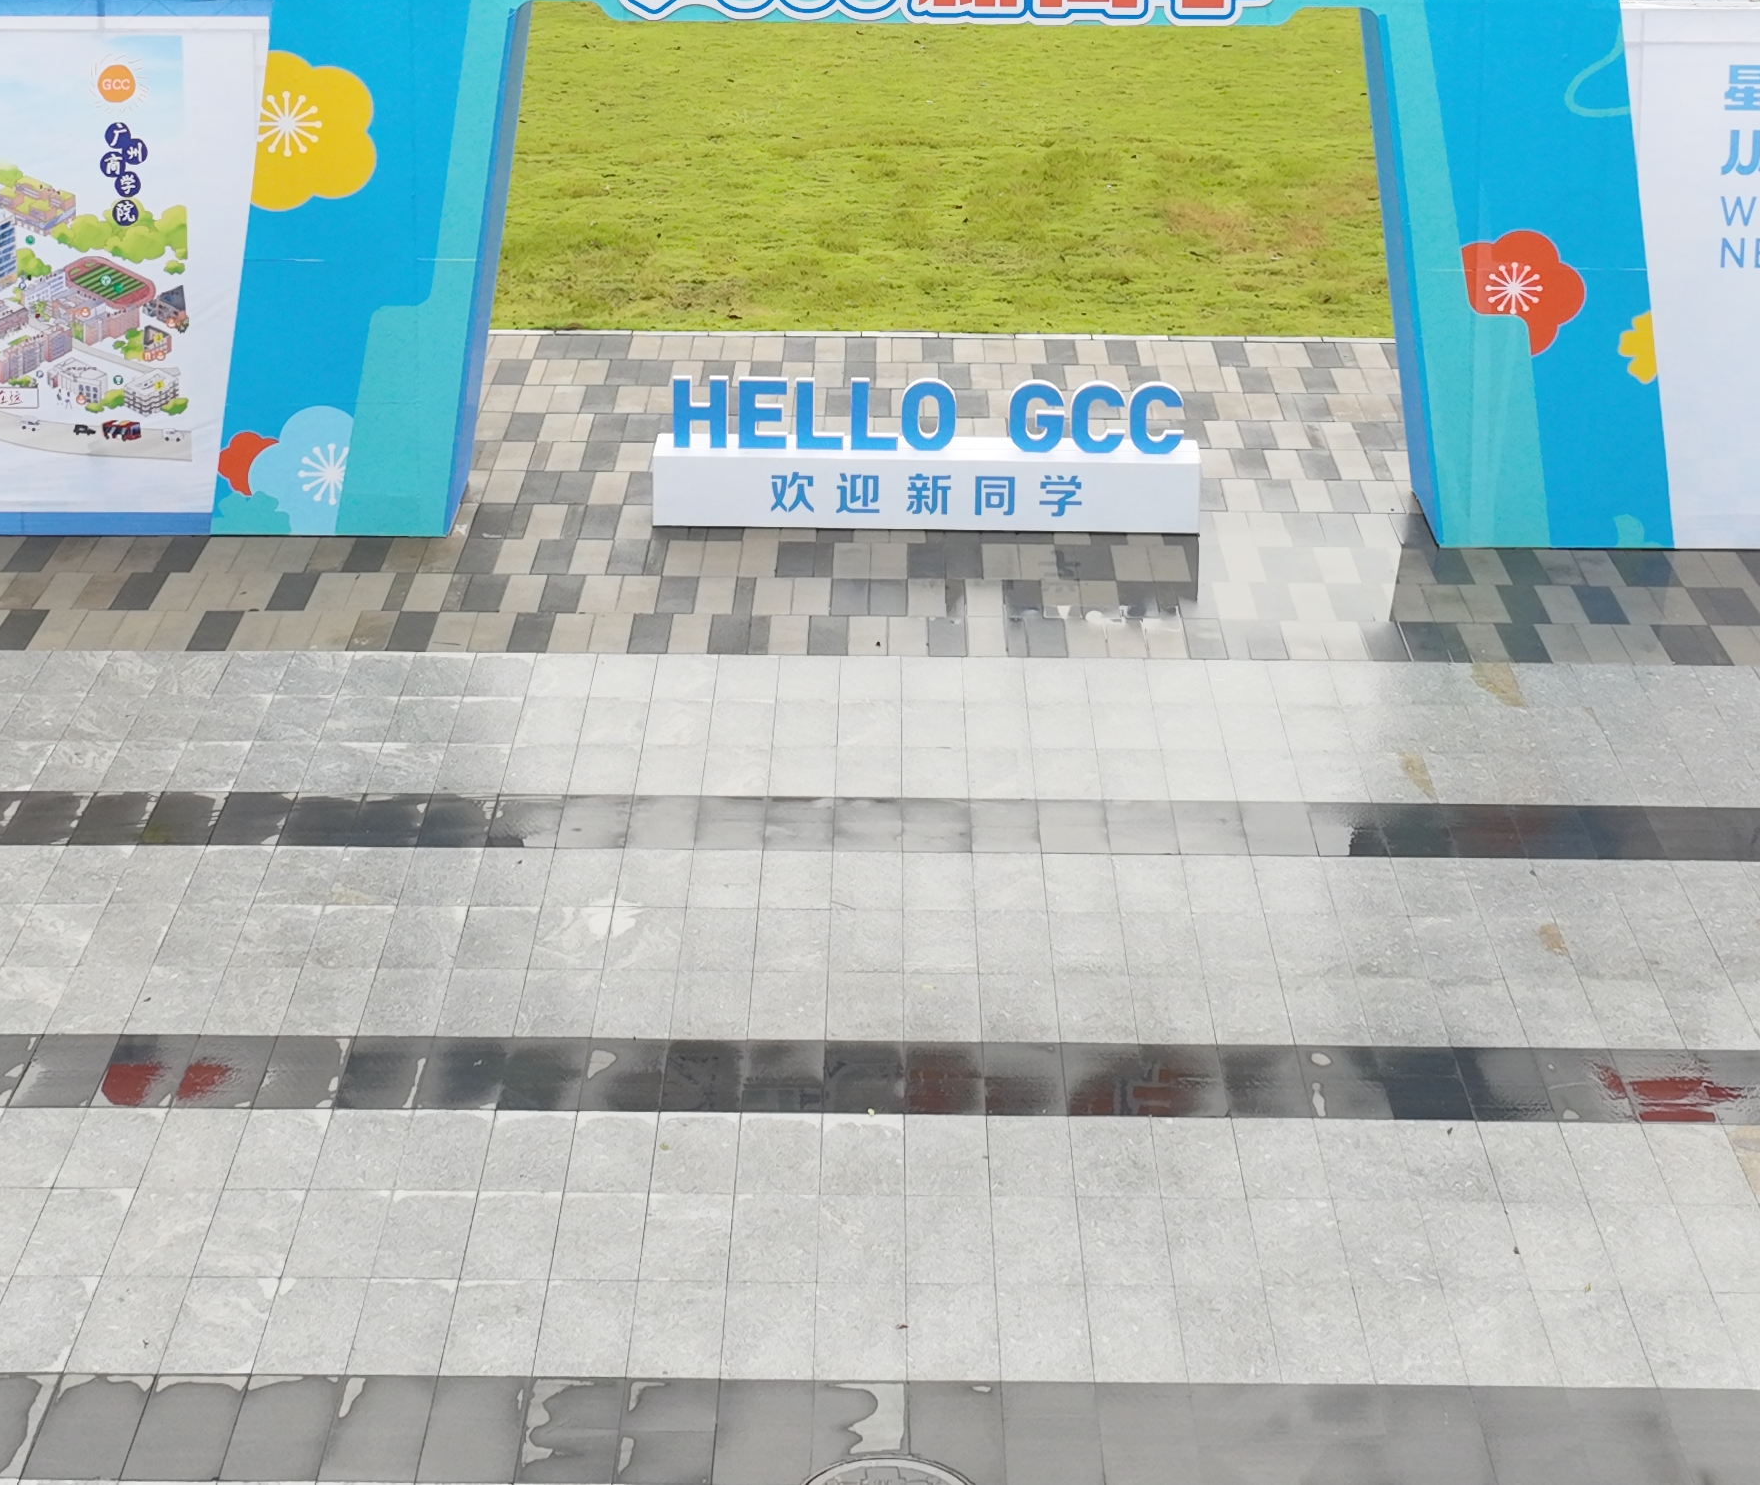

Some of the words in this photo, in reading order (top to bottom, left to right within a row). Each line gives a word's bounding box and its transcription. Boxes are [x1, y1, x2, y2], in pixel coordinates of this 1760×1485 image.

[101, 78, 131, 91] GCC
[672, 375, 958, 452] HELLO
[1007, 378, 1186, 455] GCC
[770, 471, 1086, 518] 欢迎新同学
